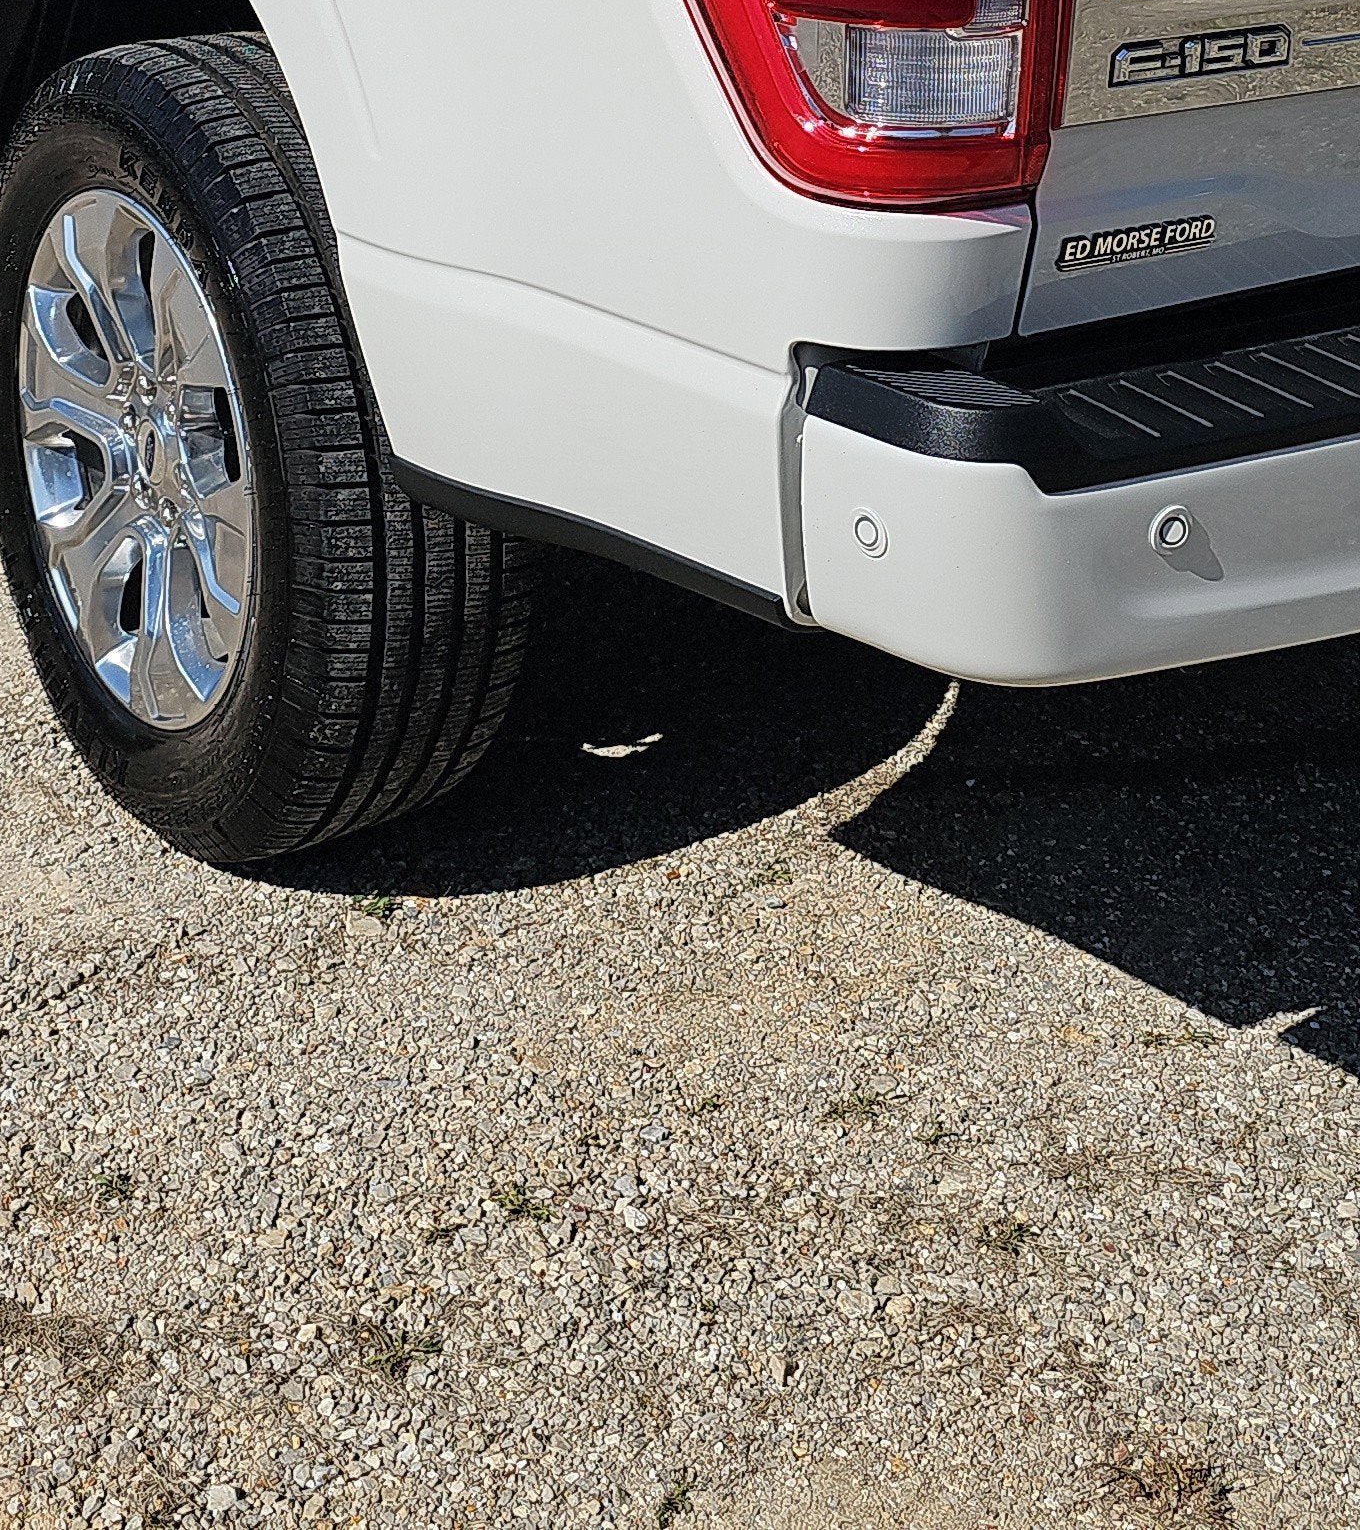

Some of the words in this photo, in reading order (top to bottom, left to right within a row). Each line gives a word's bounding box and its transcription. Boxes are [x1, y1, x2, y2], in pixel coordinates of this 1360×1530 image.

[1108, 23, 1292, 88] F-150
[1064, 240, 1092, 261] ED
[1094, 228, 1162, 256] MORSE
[1163, 219, 1216, 244] FORD
